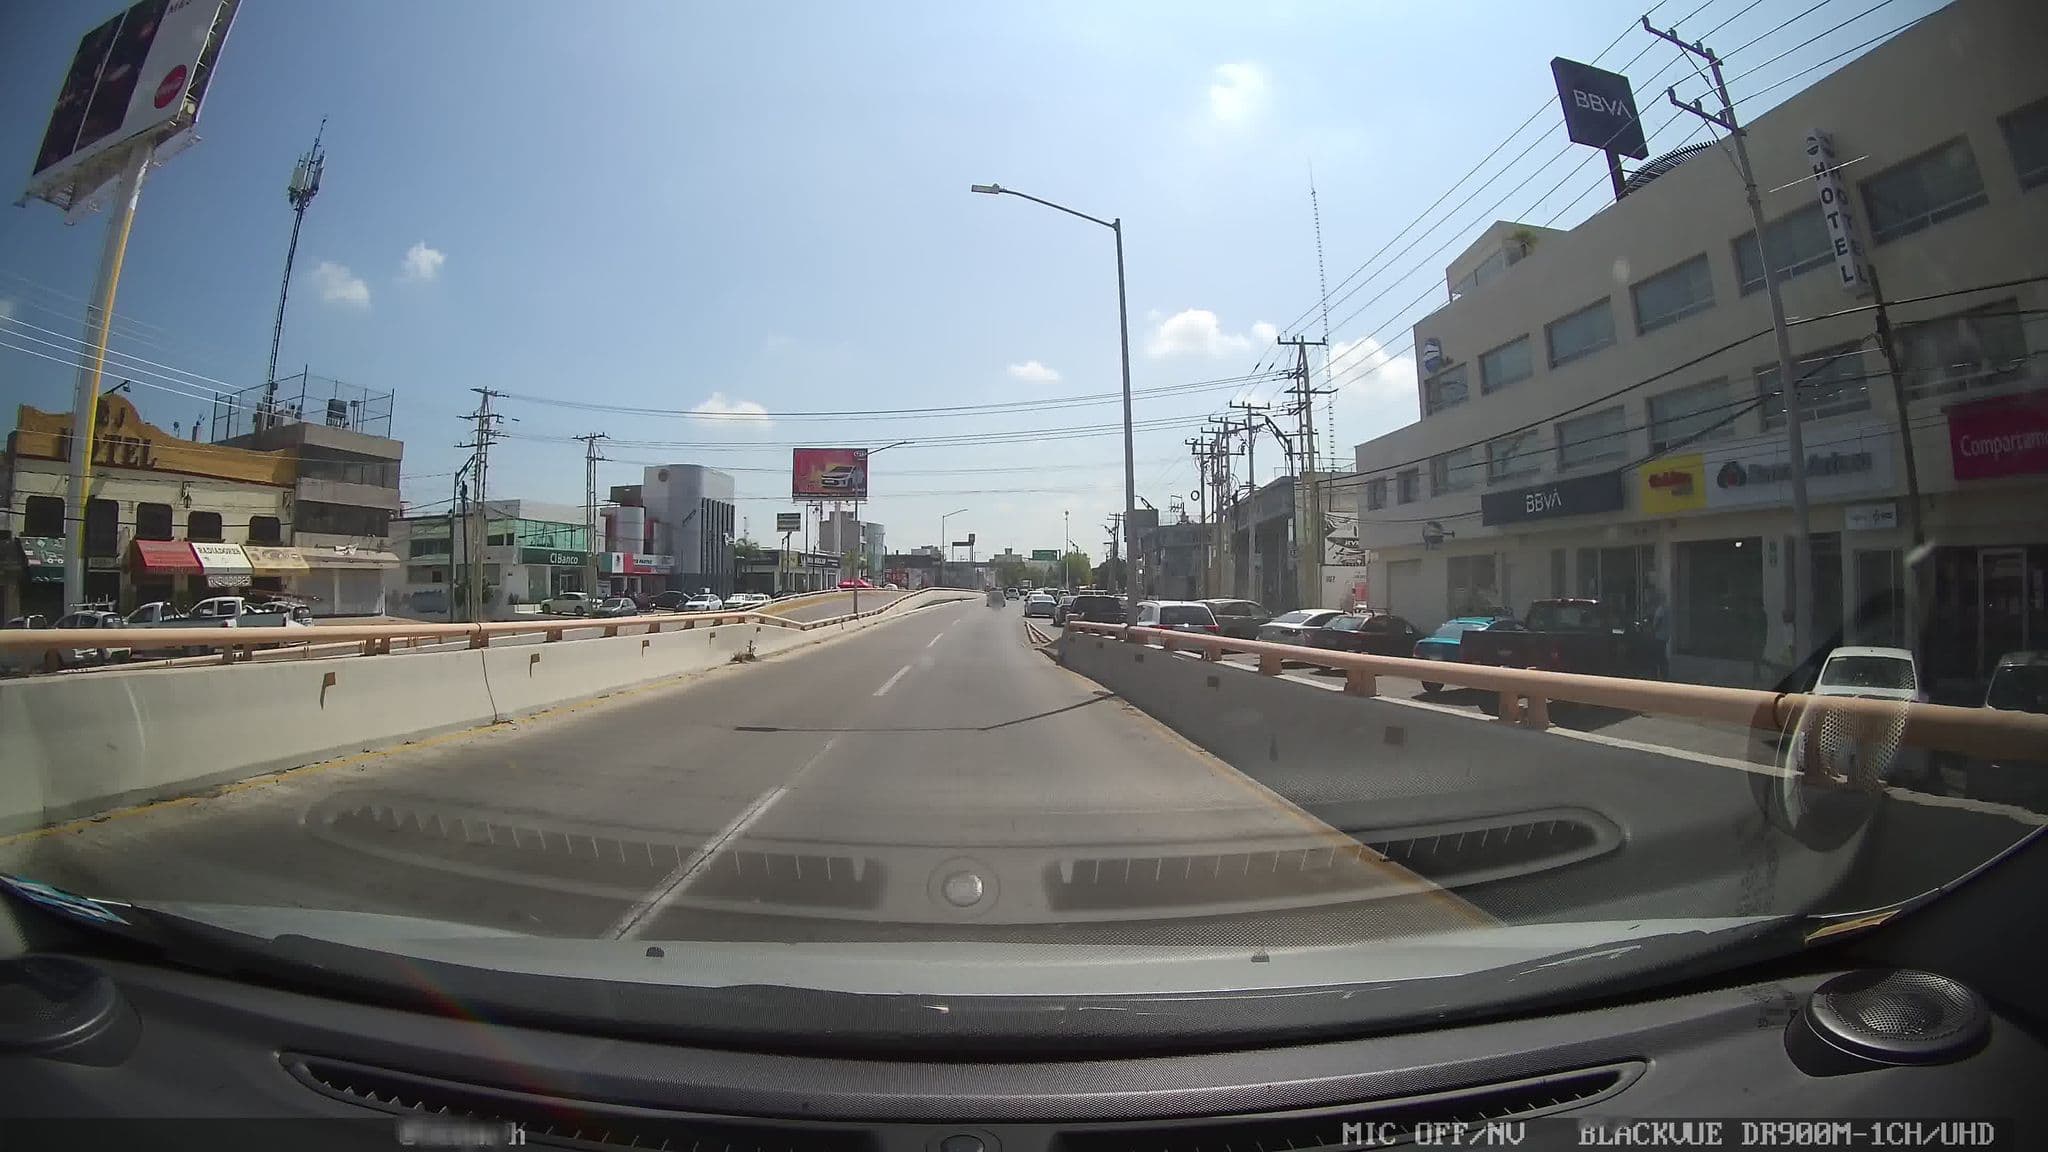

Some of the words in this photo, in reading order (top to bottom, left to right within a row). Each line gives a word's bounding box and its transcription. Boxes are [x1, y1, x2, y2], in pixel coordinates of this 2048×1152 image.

[1573, 89, 1633, 120] BBVA
[1812, 160, 1854, 283] HOTEL
[1526, 490, 1562, 513] BBVA
